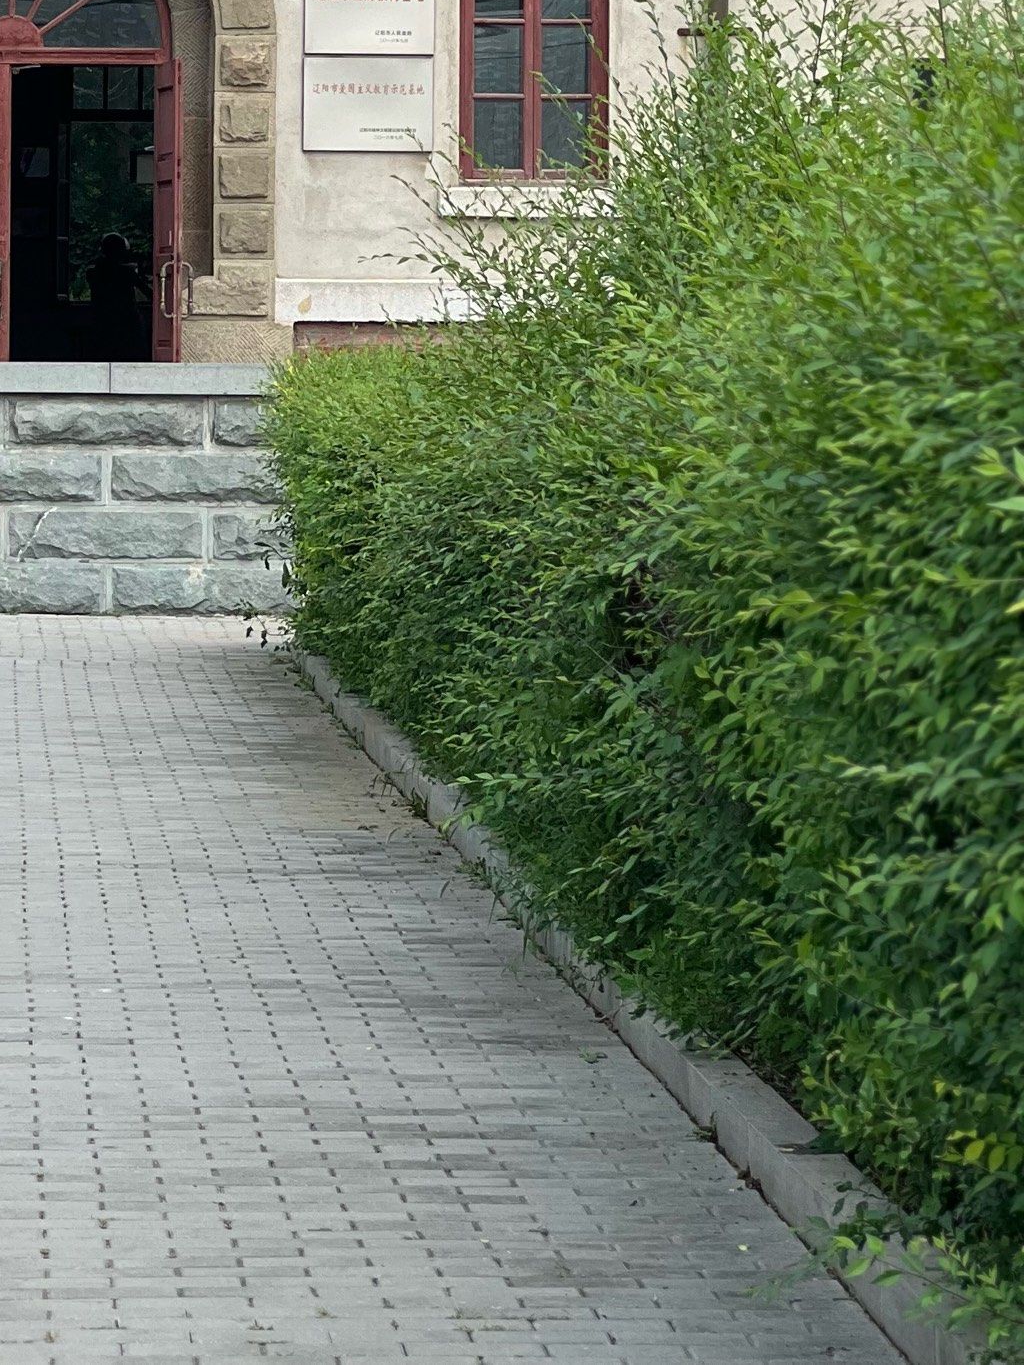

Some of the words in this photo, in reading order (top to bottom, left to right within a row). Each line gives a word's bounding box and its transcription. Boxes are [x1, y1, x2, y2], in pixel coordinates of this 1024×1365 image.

[312, 83, 425, 95] 辽阳市爱国主义教育示范基地
